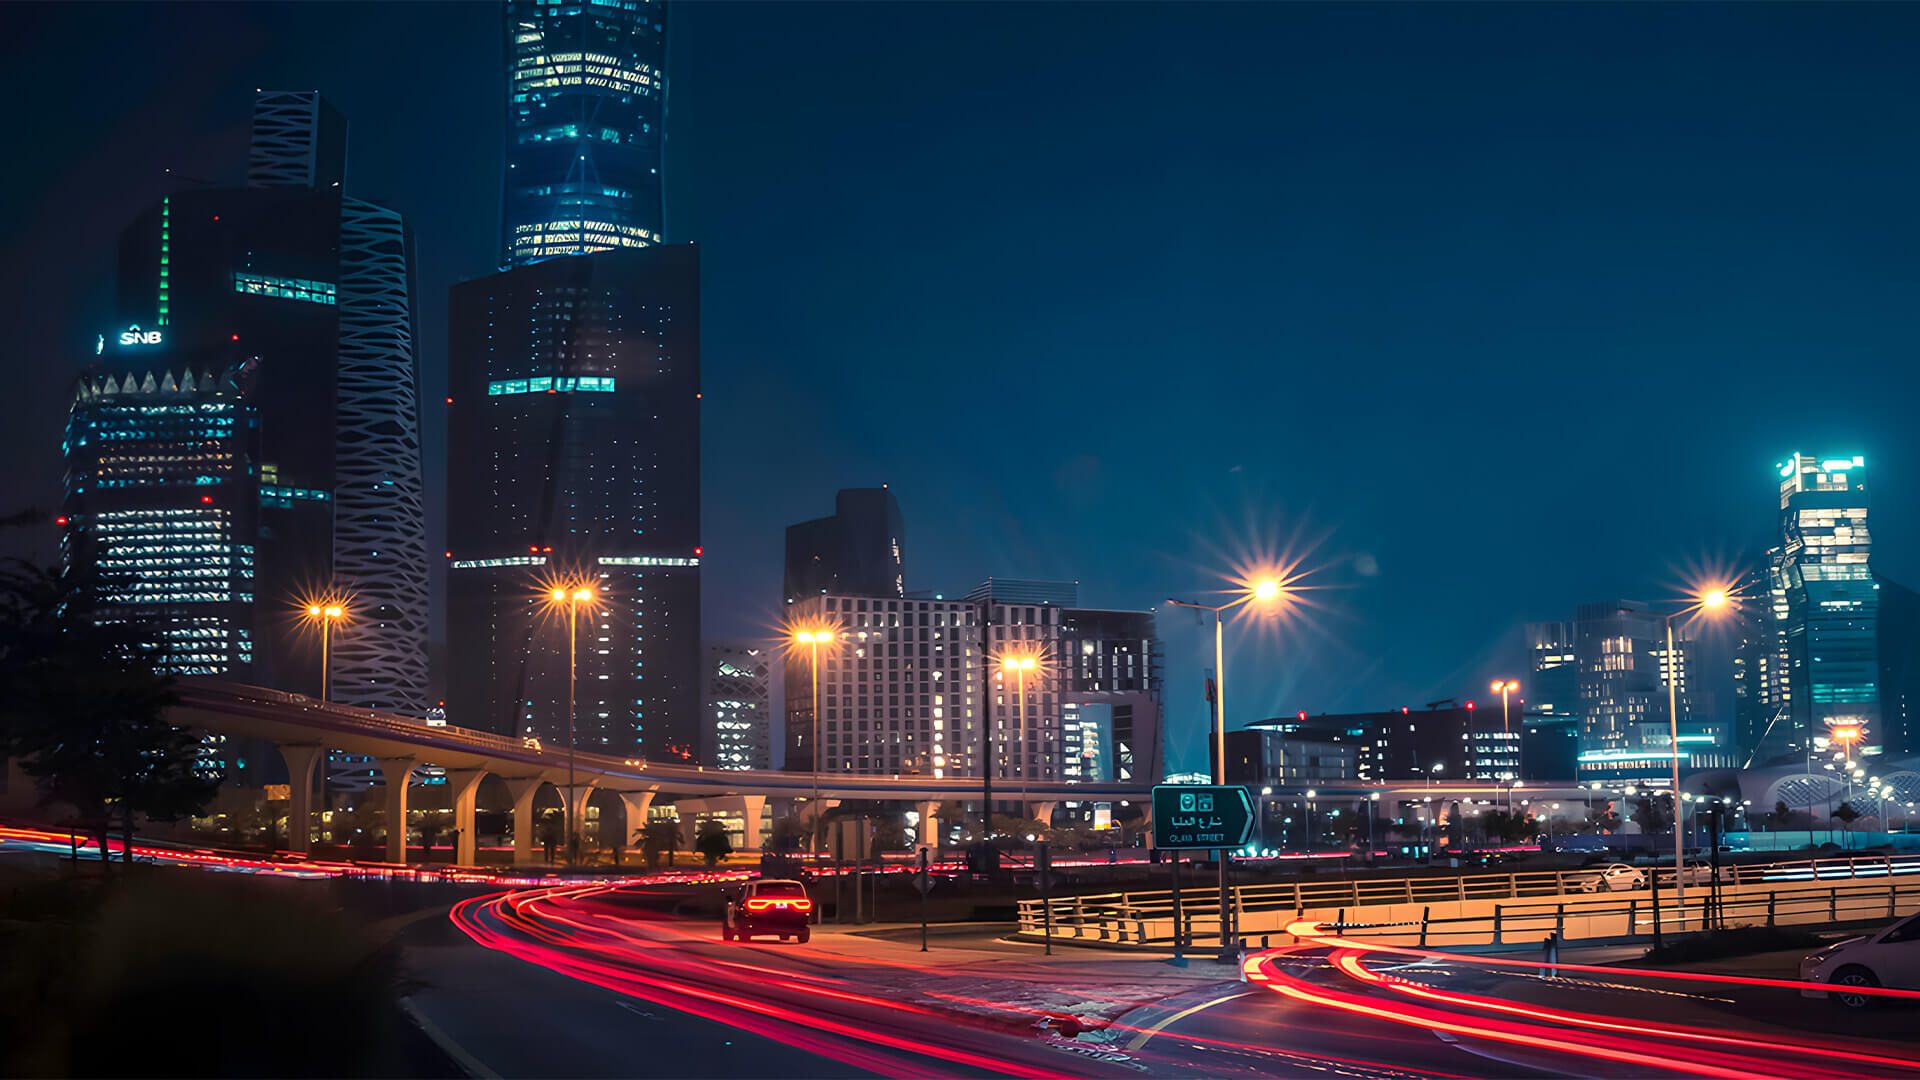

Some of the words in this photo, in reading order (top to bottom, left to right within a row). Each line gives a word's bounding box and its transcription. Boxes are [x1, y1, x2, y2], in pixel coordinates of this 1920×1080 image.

[119, 331, 162, 345] SNB
[1198, 816, 1223, 829] شارع
[1196, 833, 1225, 842] STREET
